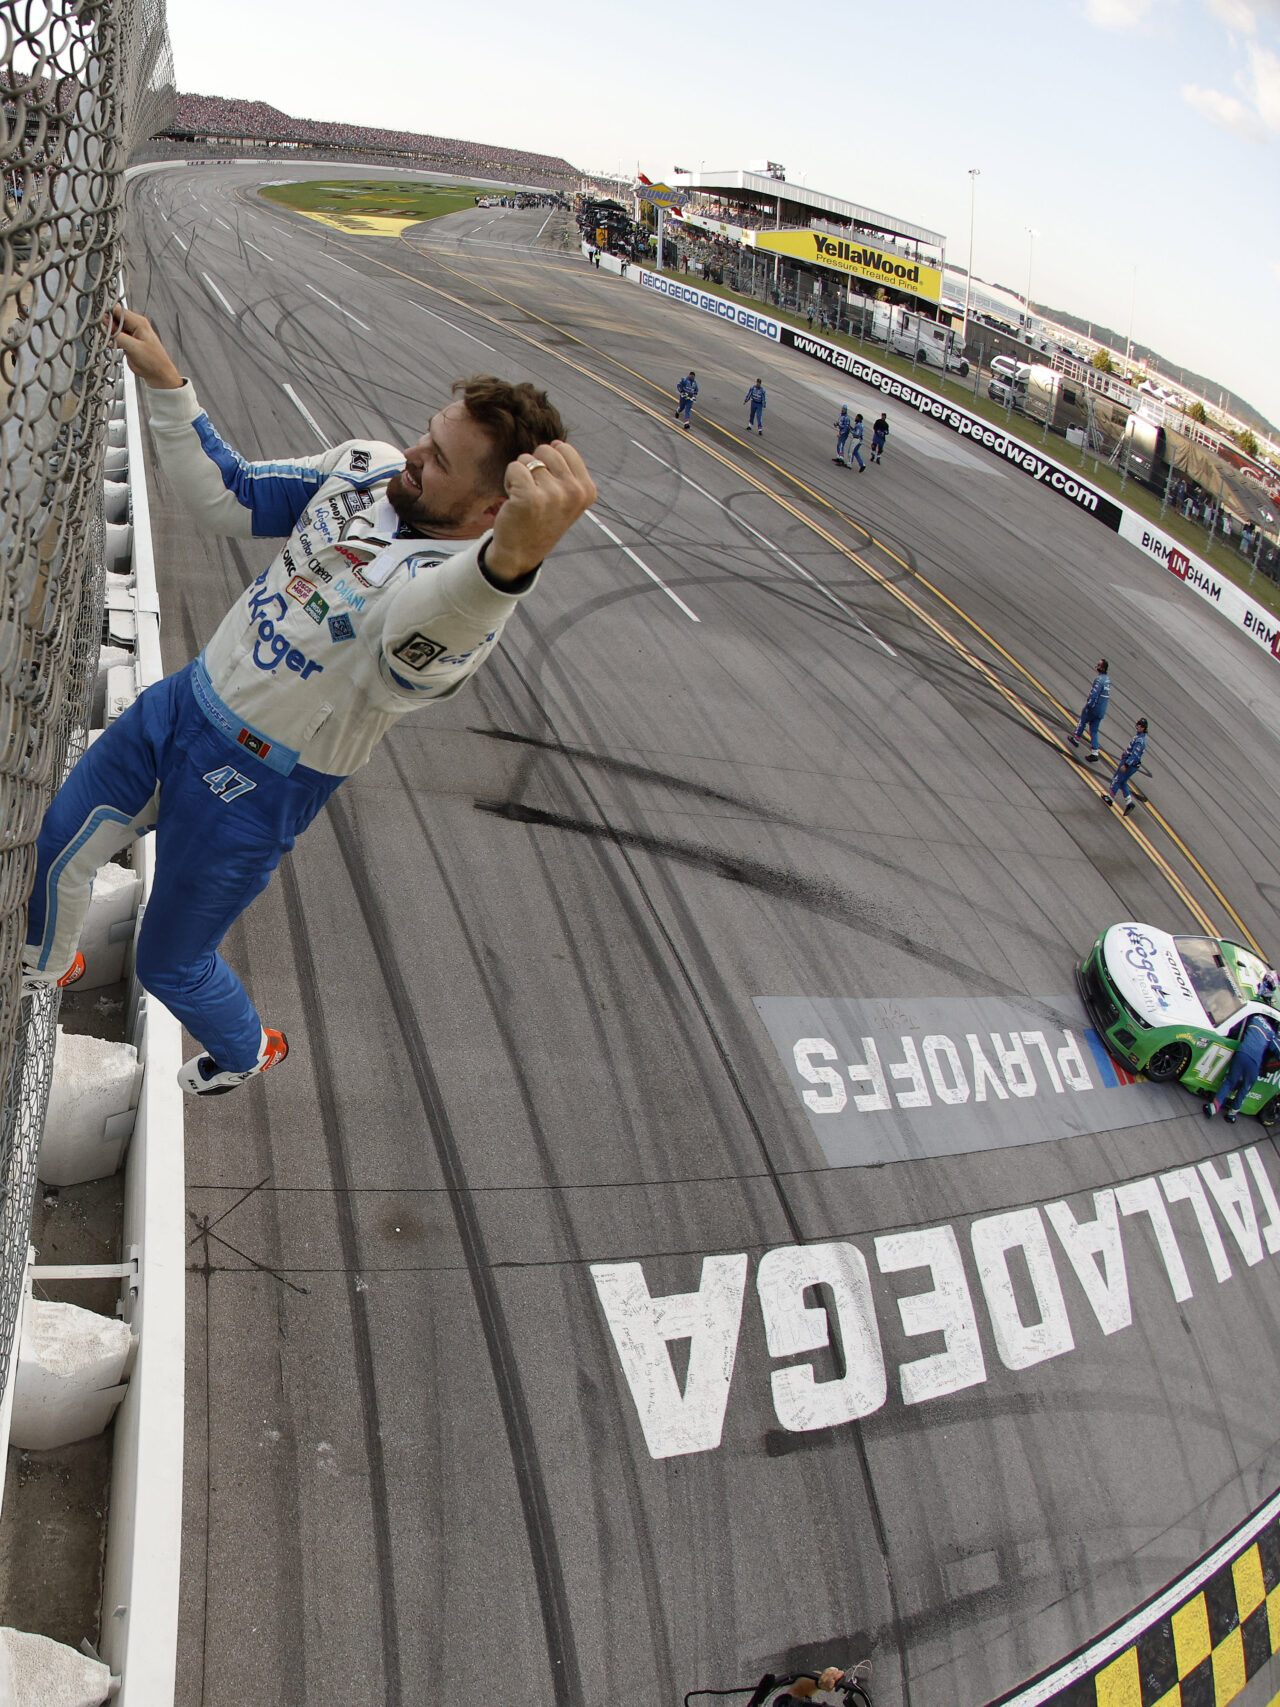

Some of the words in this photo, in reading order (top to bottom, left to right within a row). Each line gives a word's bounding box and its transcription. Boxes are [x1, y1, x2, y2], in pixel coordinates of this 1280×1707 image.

[639, 187, 687, 206] SUNOCO
[813, 234, 920, 283] YellaWood
[816, 253, 858, 273] Pressure
[861, 267, 896, 285] Treated
[898, 280, 918, 292] Pine
[642, 273, 668, 293] GEICO
[668, 283, 699, 305] GEICO
[700, 295, 736, 320] GEICO
[737, 310, 778, 339] GEICO
[793, 334, 1099, 511] www.talladegasuperspeedway.com
[1141, 531, 1222, 602] BIRMINGHAM
[248, 586, 325, 681] Kroger
[202, 765, 259, 804] 47
[1166, 949, 1193, 1000] sanofi
[793, 1029, 1095, 1114] PLAYOFFS
[1193, 1043, 1235, 1083] 47
[589, 1146, 1280, 1460] TALLADEGA
